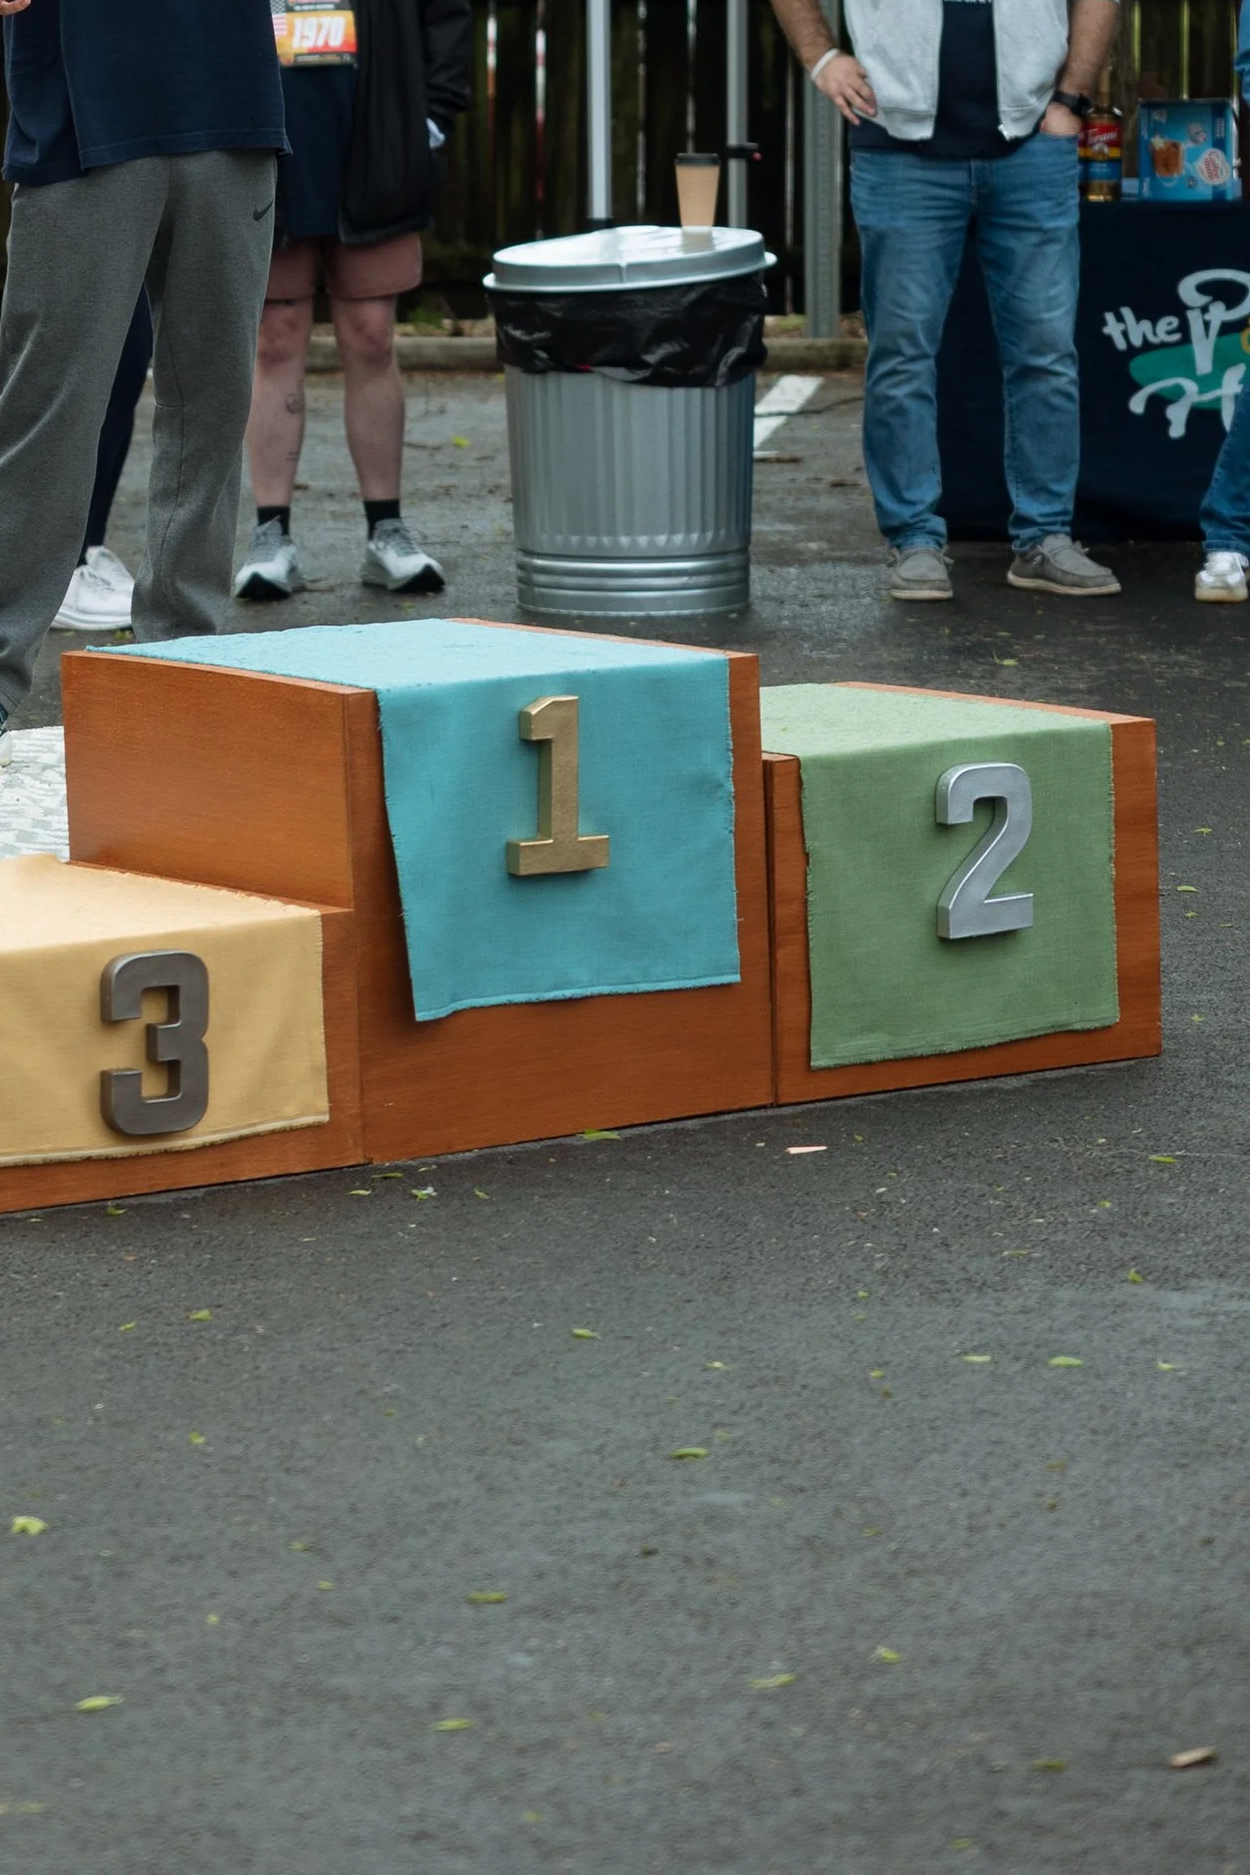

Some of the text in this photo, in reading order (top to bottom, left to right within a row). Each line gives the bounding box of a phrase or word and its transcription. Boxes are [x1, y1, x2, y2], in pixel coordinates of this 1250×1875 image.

[291, 16, 347, 49] 1970
[1102, 305, 1183, 352] the
[507, 694, 609, 877] 1
[935, 761, 1034, 940] 2
[100, 950, 210, 1137] 3
